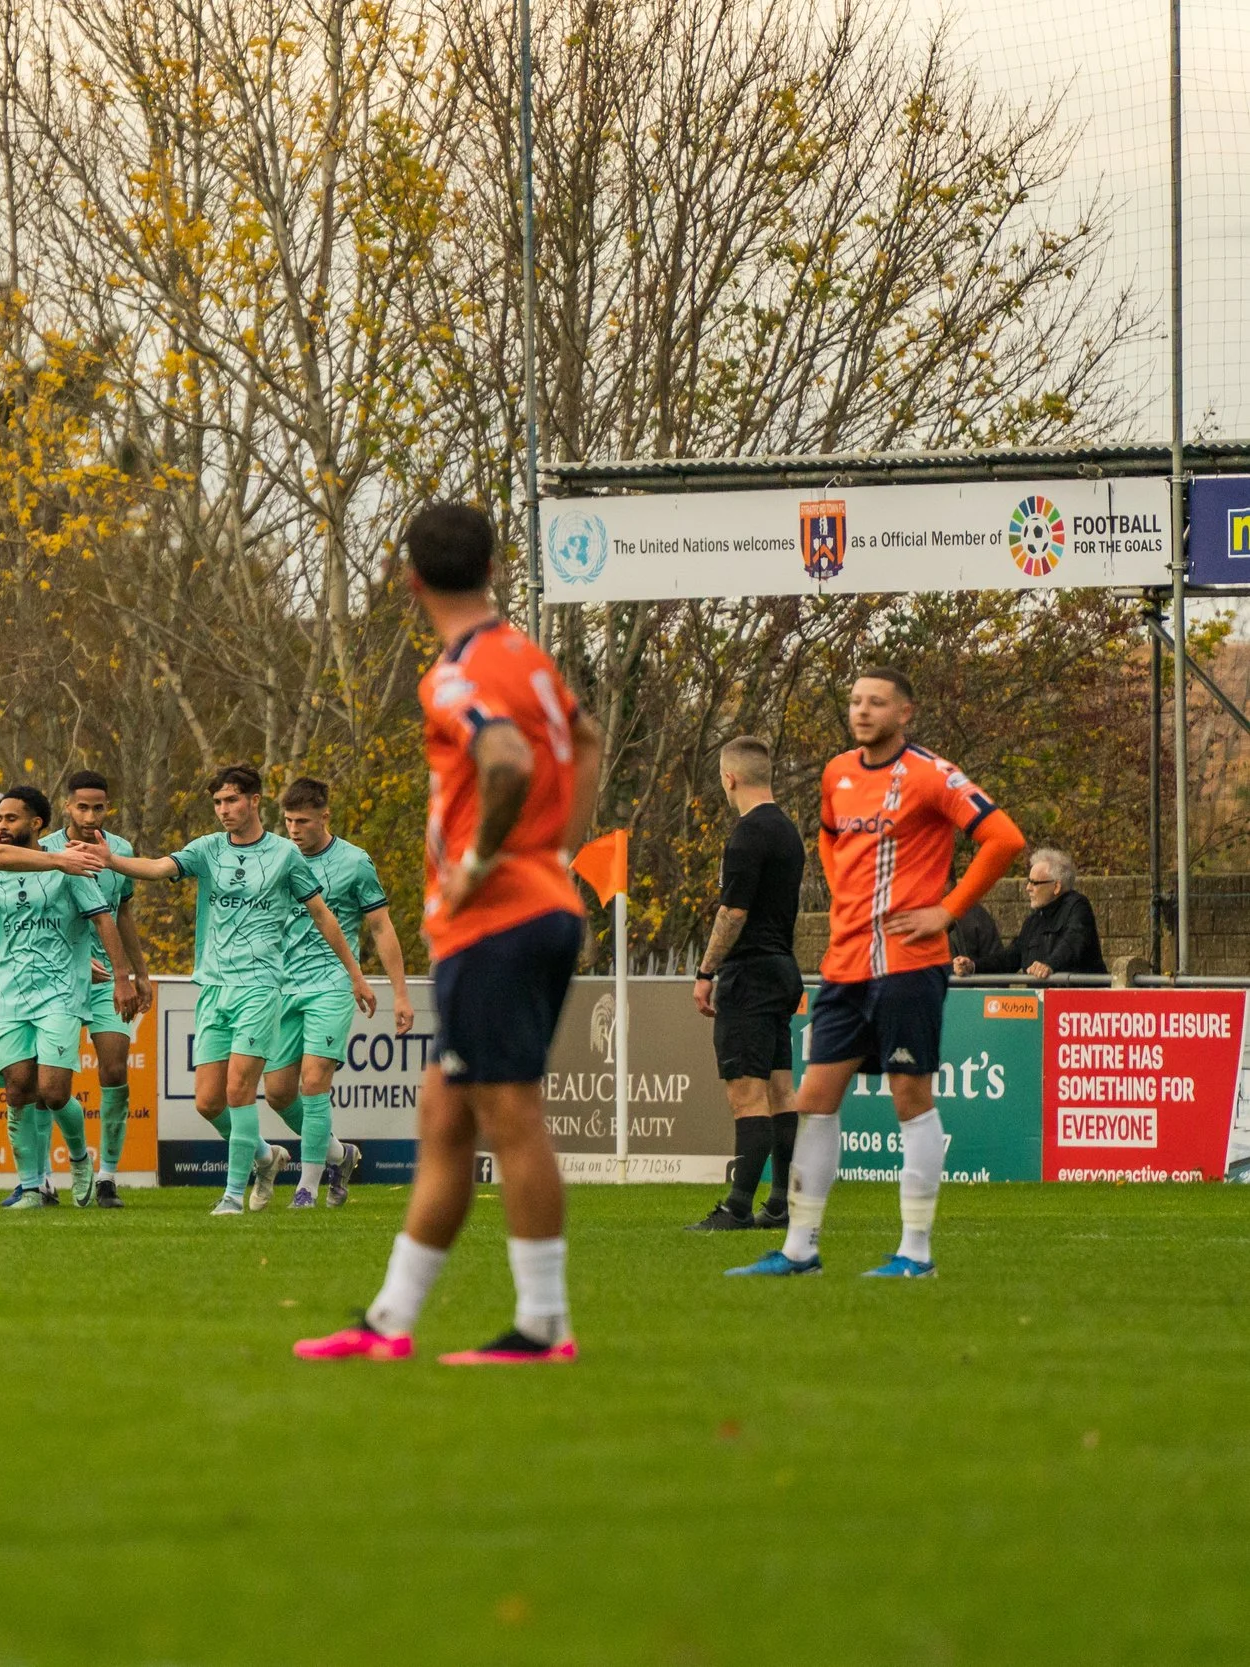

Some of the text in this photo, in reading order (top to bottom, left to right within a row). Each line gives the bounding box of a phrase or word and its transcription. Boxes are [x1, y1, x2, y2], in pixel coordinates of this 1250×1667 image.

[1073, 514, 1161, 535] FOOTBALL
[614, 536, 795, 555] The United Nations welcomes
[851, 529, 1002, 548] as a Official Member of
[1074, 538, 1162, 554] FOR THE GOALS
[220, 897, 272, 911] GEMINI
[14, 918, 61, 932] GEMINI
[1001, 1002, 1033, 1013] Kubota
[1058, 1012, 1231, 1038] STRATFORD LEISURE
[336, 1033, 434, 1072] COTT
[1058, 1044, 1163, 1070] CENTRE HAS
[1058, 1076, 1195, 1102] SOMETHING FOR
[543, 1108, 676, 1138] SKIN & BAUTY
[1062, 1114, 1153, 1141] EVERYONE
[840, 1131, 882, 1152] 1608
[562, 1158, 585, 1173] Lisa
[588, 1161, 602, 1172] on
[605, 1158, 639, 1173] 0717
[642, 1159, 682, 1174] 710365
[1058, 1165, 1203, 1182] everyoneactive.com
